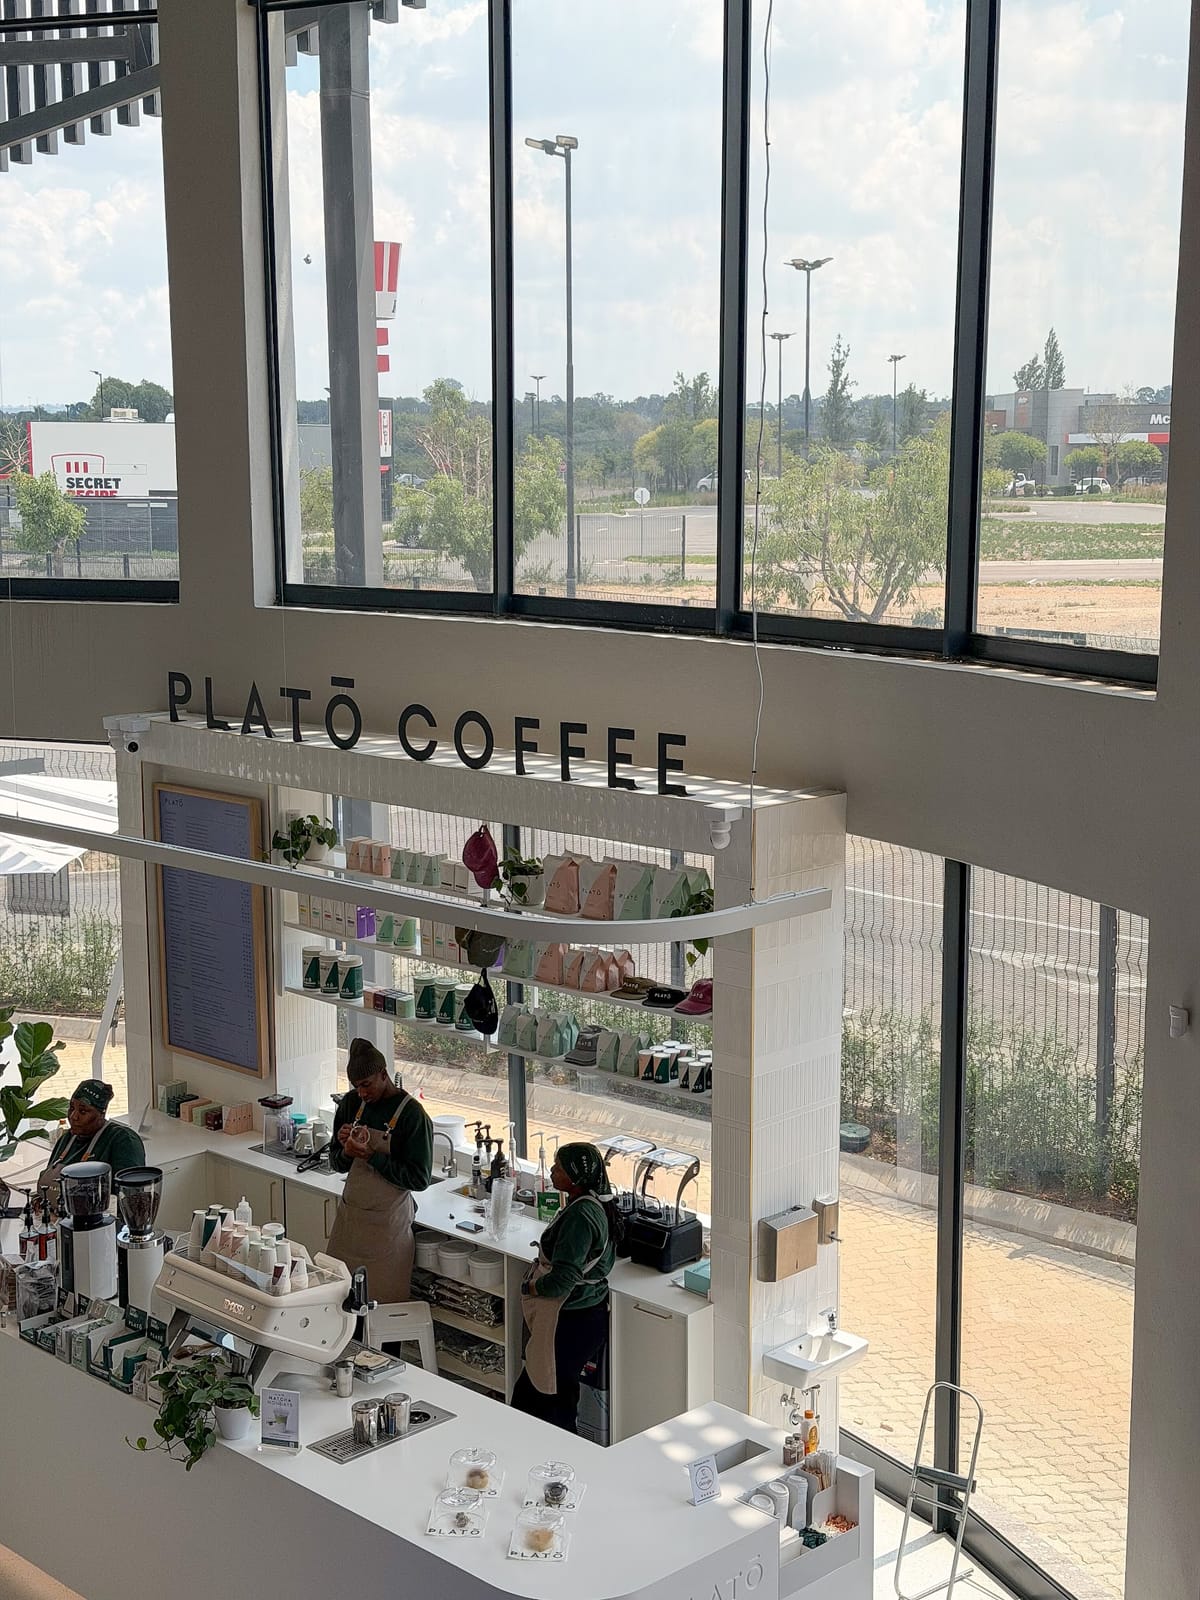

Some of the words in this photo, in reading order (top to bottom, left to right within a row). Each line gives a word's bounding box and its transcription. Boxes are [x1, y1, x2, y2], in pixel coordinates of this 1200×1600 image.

[66, 477, 121, 489] SECRET
[168, 671, 362, 750] PLATŌ
[398, 703, 688, 797] COFFEE
[510, 1550, 563, 1558] PLATŌ
